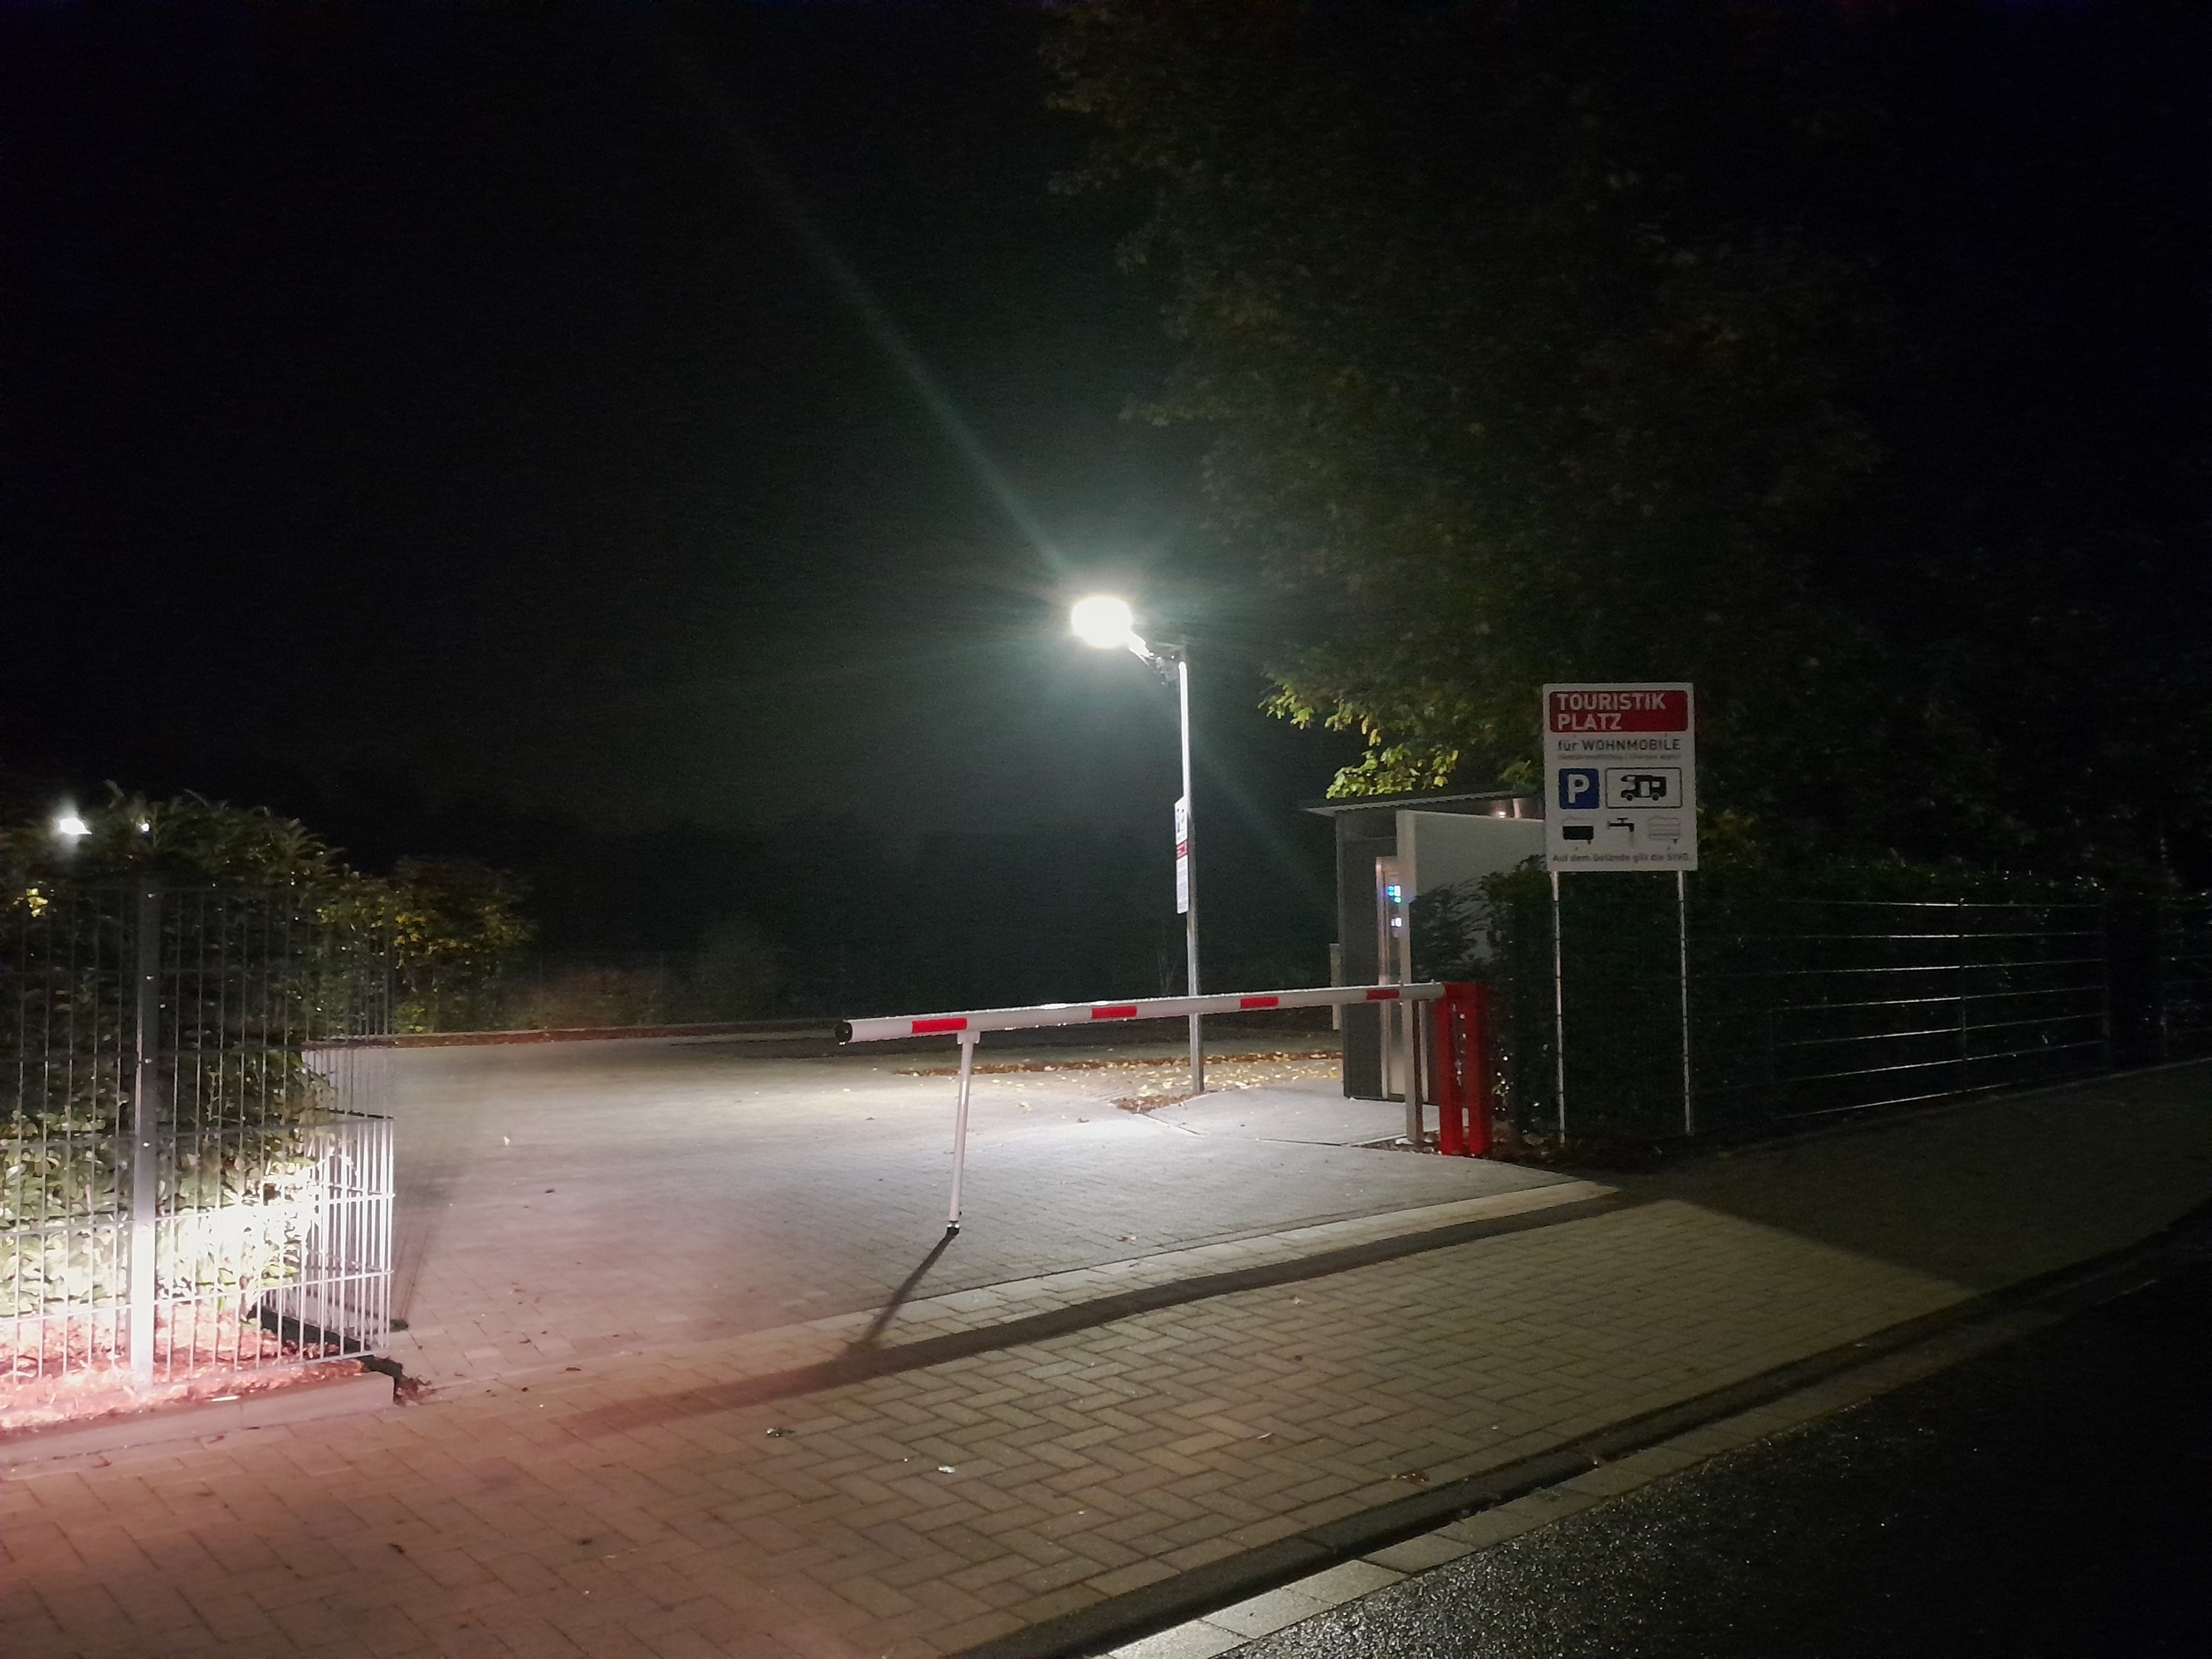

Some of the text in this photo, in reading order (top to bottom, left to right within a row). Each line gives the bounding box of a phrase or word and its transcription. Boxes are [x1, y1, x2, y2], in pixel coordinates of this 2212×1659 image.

[1557, 693, 1667, 711] TOURISTIK
[1557, 713, 1623, 731] PLATZ
[1581, 738, 1681, 751] WOHNMOBILE
[1566, 773, 1591, 804] P
[1552, 854, 1568, 862] Auf
